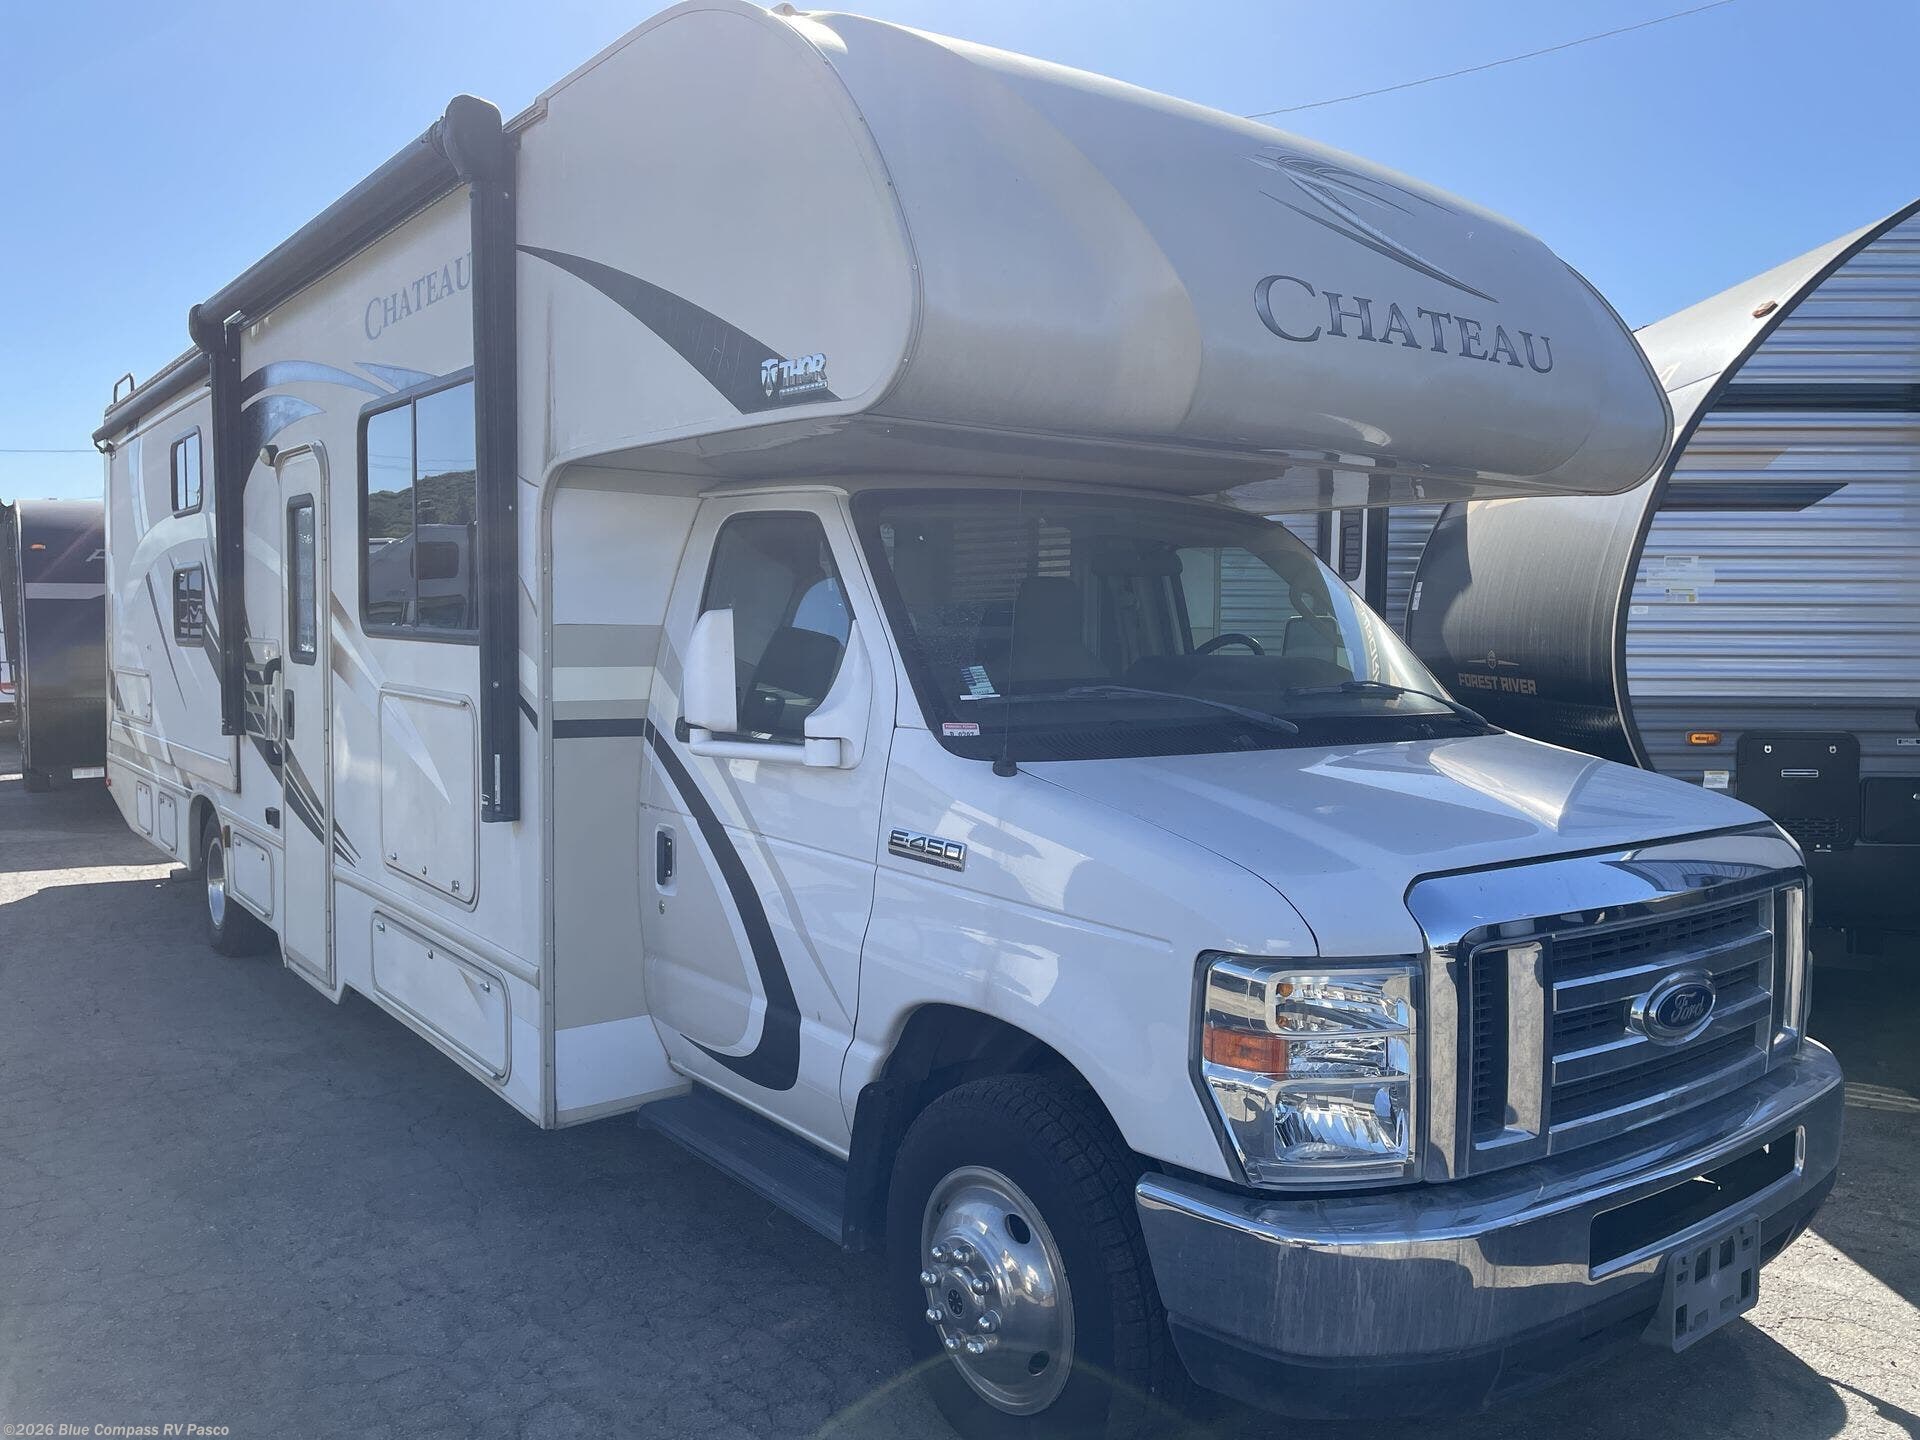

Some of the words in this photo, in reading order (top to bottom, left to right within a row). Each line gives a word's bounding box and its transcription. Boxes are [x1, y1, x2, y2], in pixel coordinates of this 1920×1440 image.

[364, 252, 471, 341] CHATEAU
[1254, 275, 1554, 374] CHATEAU
[779, 353, 827, 388] THOR
[1458, 673, 1498, 690] FOREST
[1500, 677, 1538, 696] RIVER
[1671, 992, 1705, 1023] Ford
